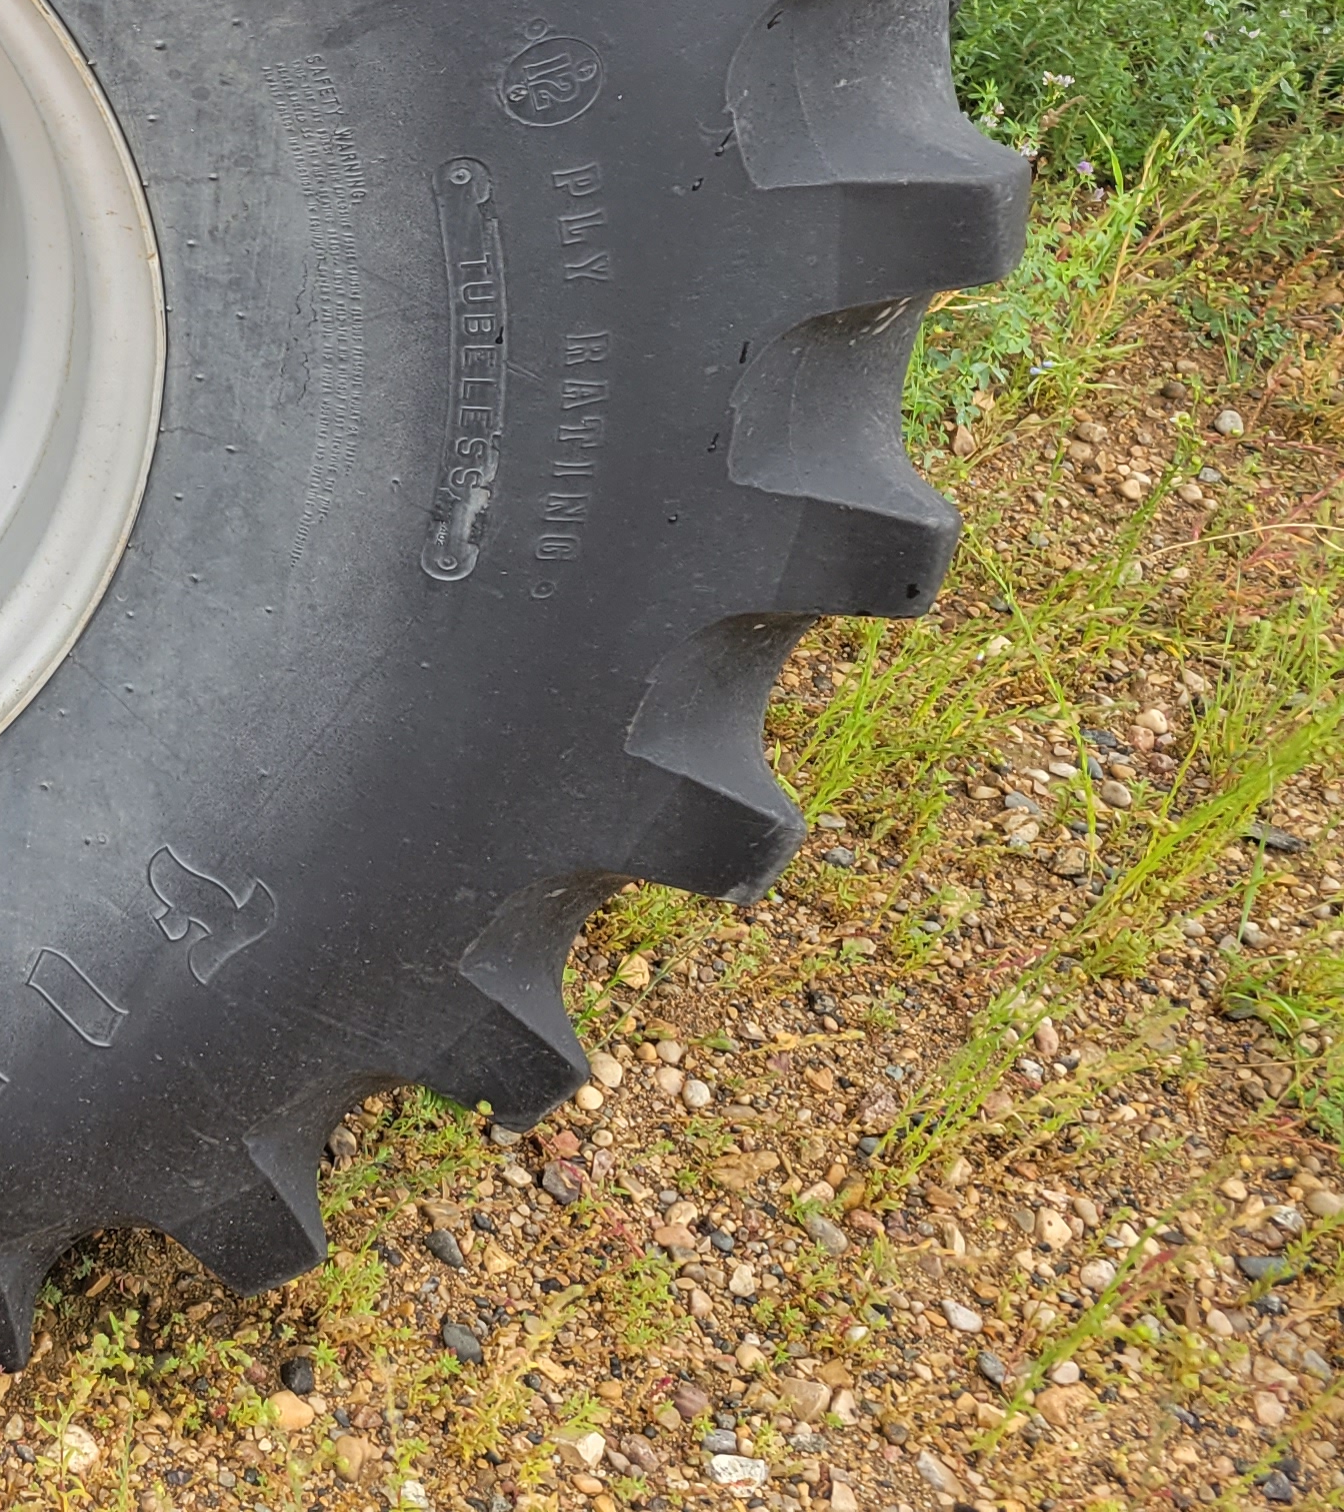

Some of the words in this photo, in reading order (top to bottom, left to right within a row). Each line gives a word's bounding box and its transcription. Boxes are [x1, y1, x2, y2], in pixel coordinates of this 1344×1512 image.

[303, 53, 345, 116] SAFETY
[551, 162, 610, 281] PLY
[448, 252, 498, 491] TUBELESS
[535, 331, 609, 561] RATING
